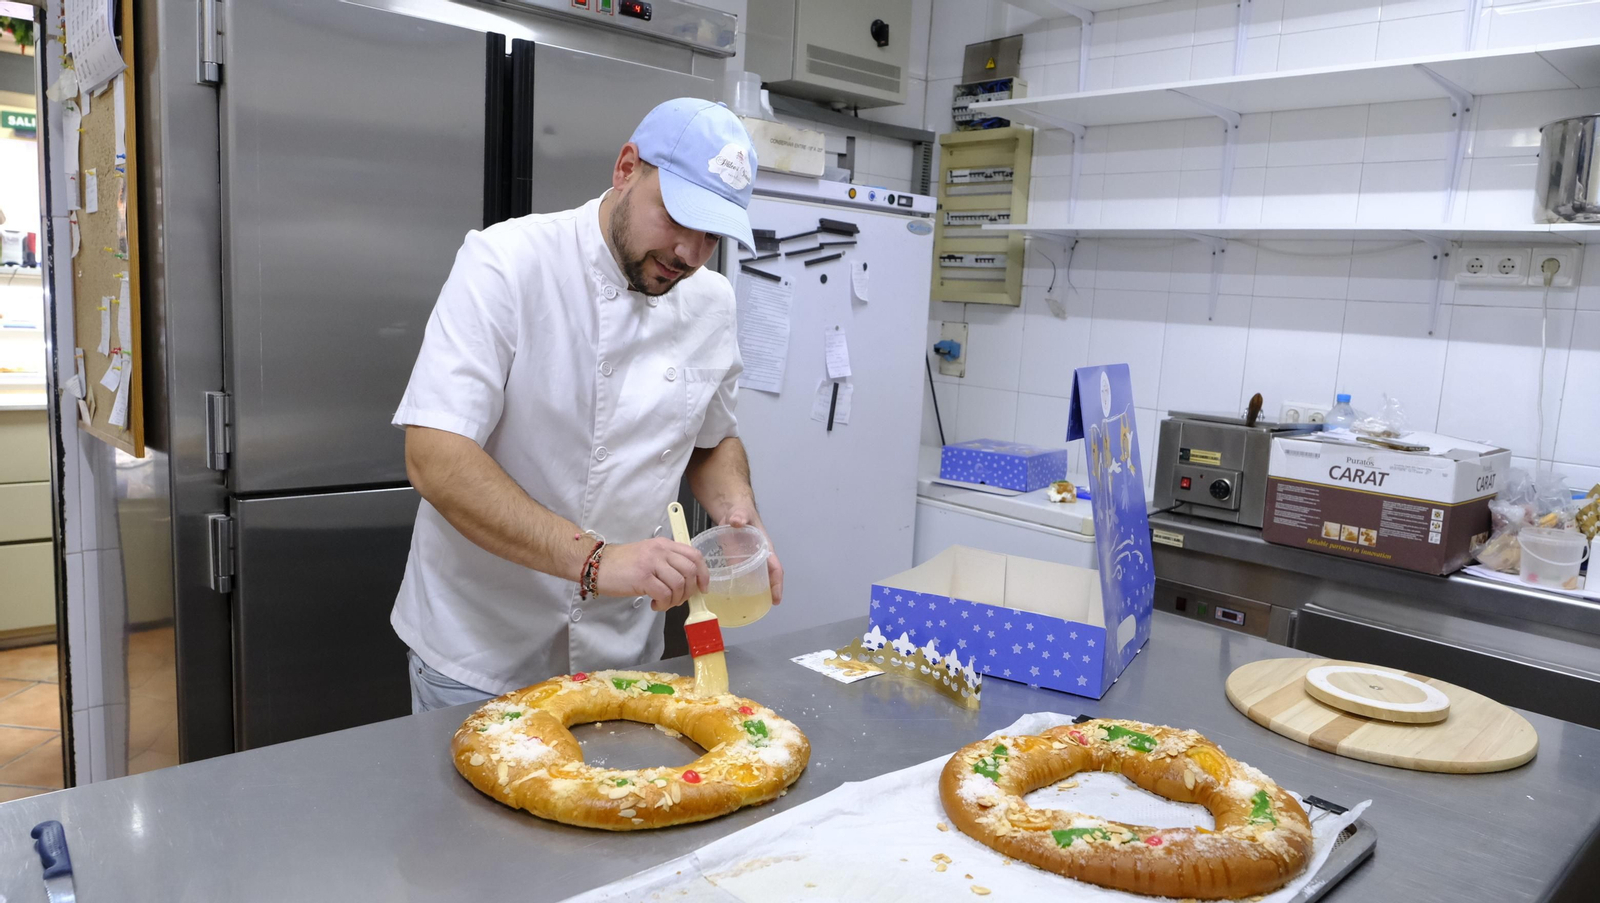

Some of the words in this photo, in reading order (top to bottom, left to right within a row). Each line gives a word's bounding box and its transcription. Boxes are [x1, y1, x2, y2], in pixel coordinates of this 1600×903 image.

[1346, 456, 1375, 466] Puratos
[1329, 465, 1390, 486] CARAT
[1476, 473, 1496, 492] CARAT
[1307, 538, 1328, 547] Reliable
[1329, 543, 1352, 552] partners
[1361, 549, 1392, 559] innovation
